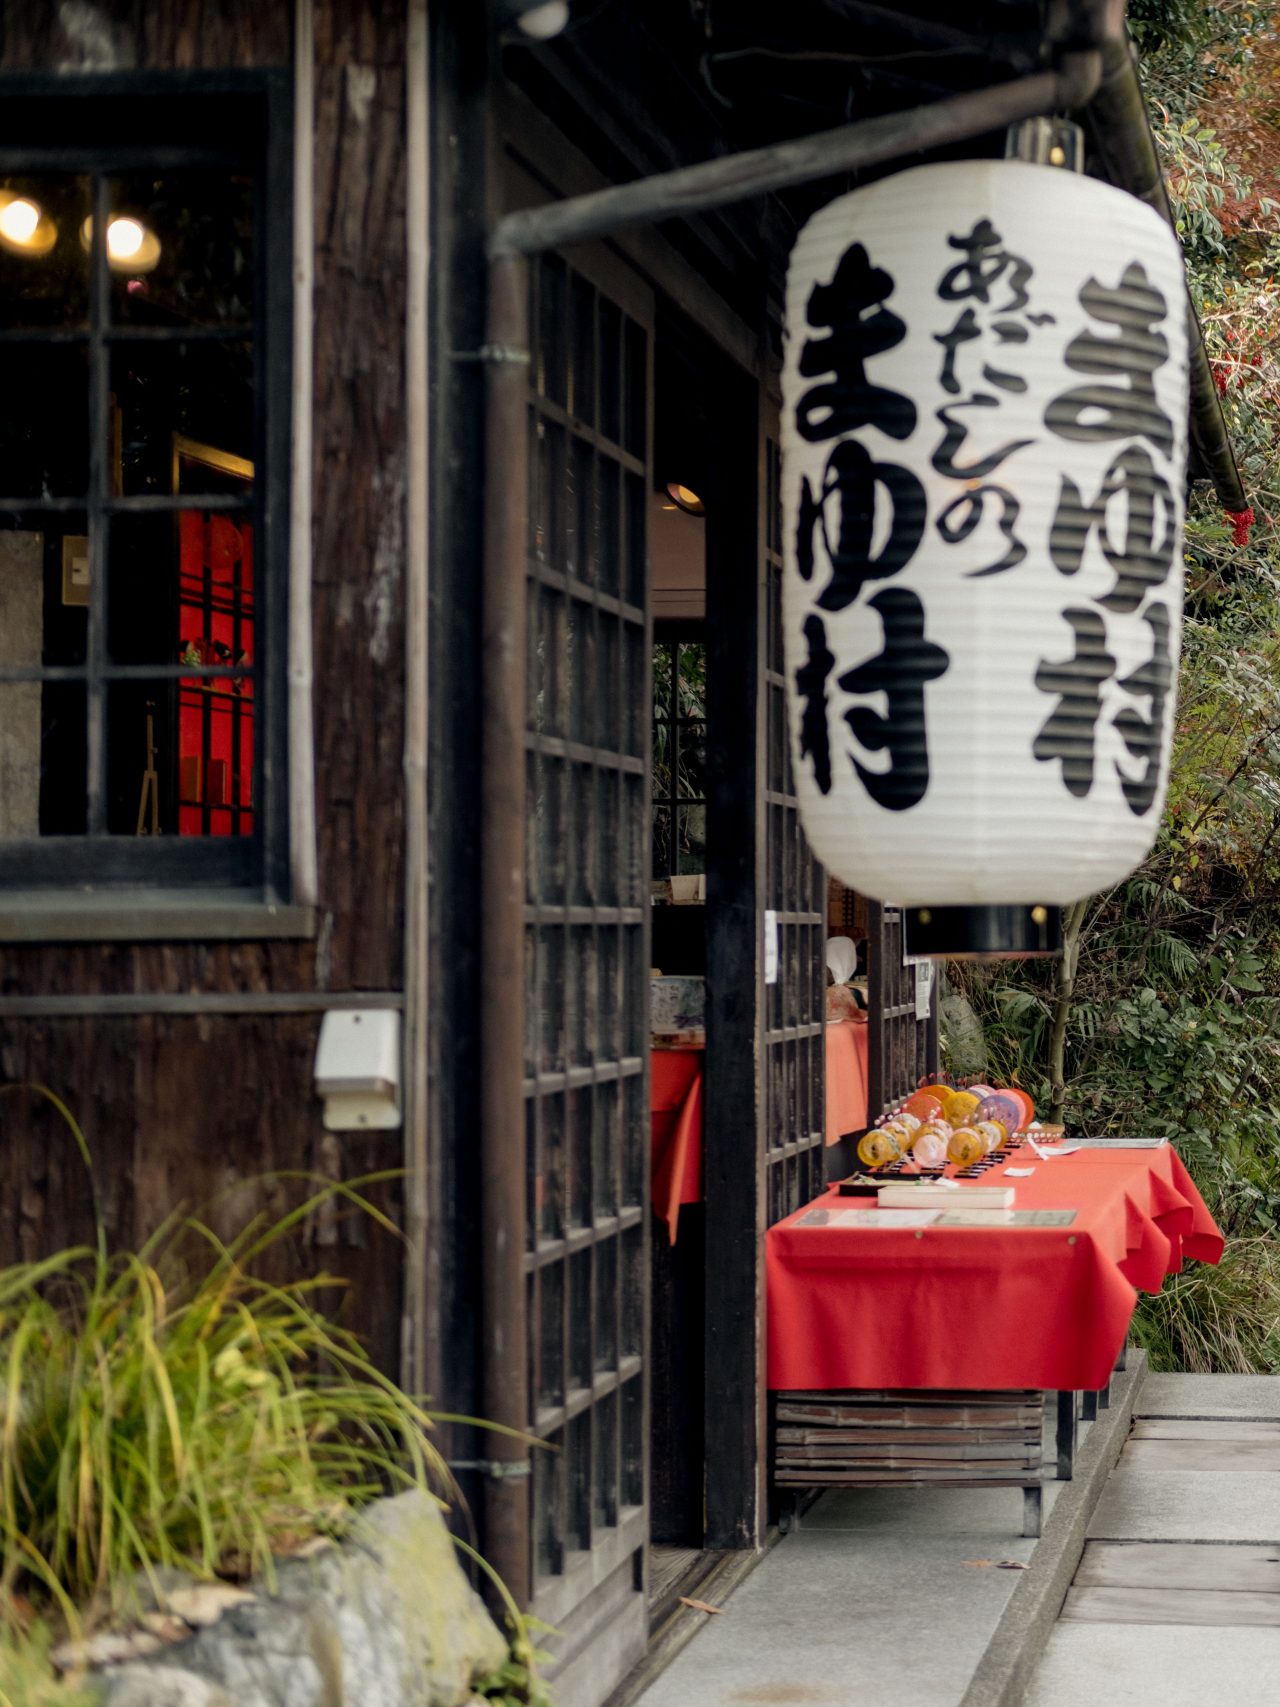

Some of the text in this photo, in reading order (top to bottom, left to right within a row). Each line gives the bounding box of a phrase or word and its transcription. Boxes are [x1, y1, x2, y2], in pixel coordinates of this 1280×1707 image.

[796, 241, 950, 812] まゆ村
[932, 218, 1056, 578] あだしの
[1033, 260, 1176, 818] まゆ村
